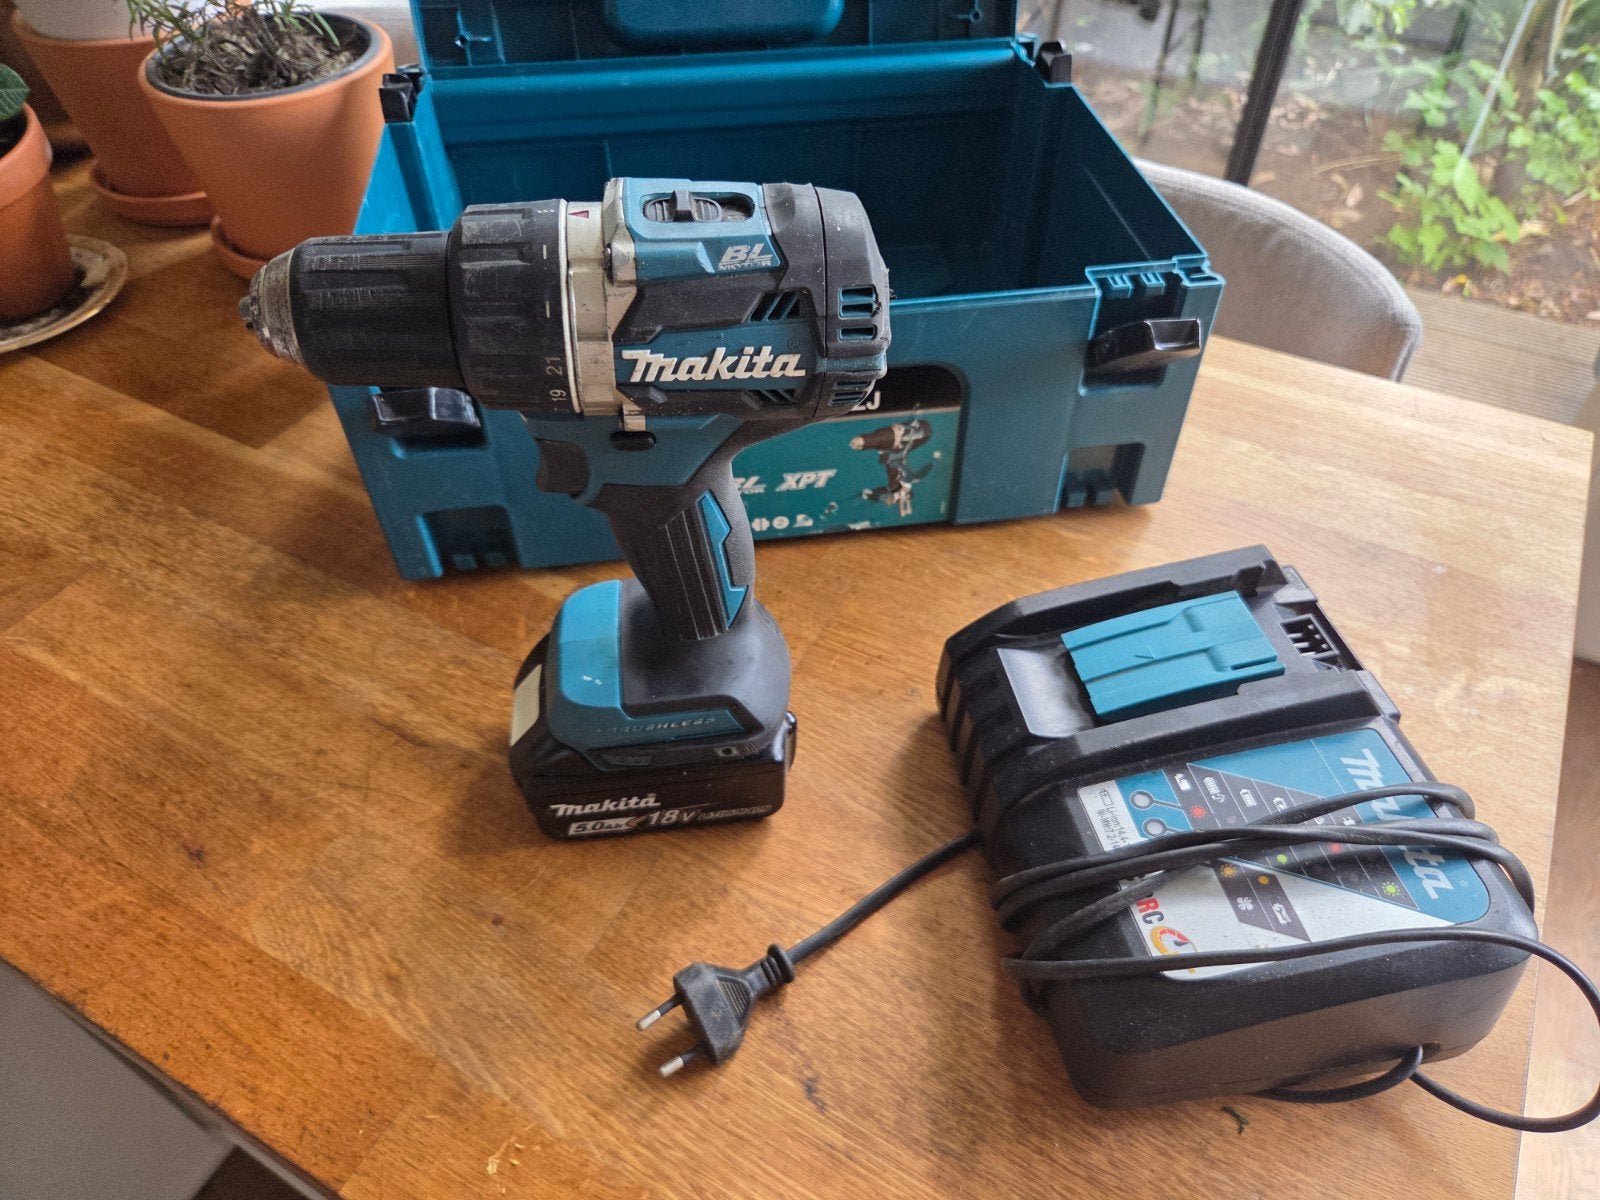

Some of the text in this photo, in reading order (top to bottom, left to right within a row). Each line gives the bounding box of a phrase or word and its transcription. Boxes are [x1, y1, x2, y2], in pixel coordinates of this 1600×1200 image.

[719, 242, 773, 264] BL
[545, 357, 567, 401] 19 21
[621, 345, 806, 383] Makita
[774, 469, 838, 492] XPT
[549, 795, 662, 817] Makita
[1340, 748, 1454, 900] Mata
